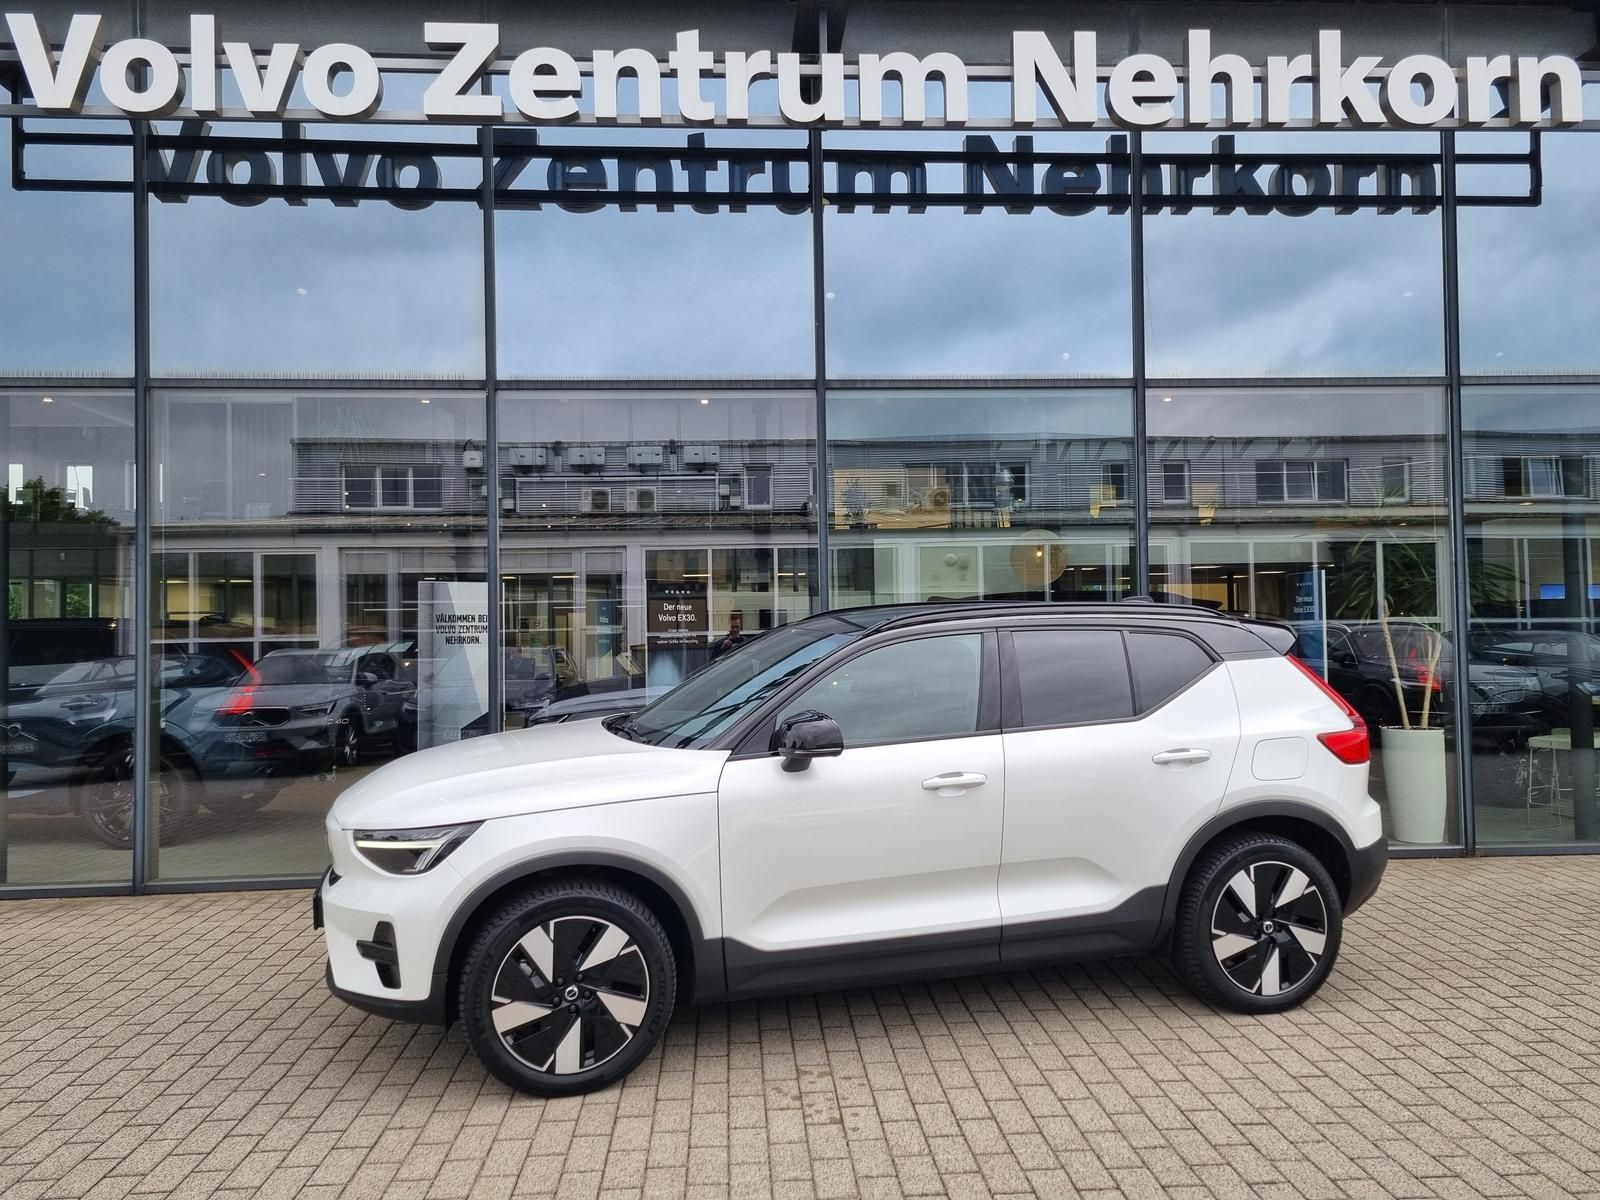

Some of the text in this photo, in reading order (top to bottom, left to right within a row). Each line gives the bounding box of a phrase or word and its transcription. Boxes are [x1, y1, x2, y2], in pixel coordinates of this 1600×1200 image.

[5, 13, 1584, 128] Volvo Zentrum Nehrkorn
[131, 121, 1436, 216] Volvo Zentrum Nehrkorn
[478, 614, 488, 622] BEI
[436, 625, 487, 633] VOLVO ZENTRUM
[445, 636, 481, 645] NEHRKORN.
